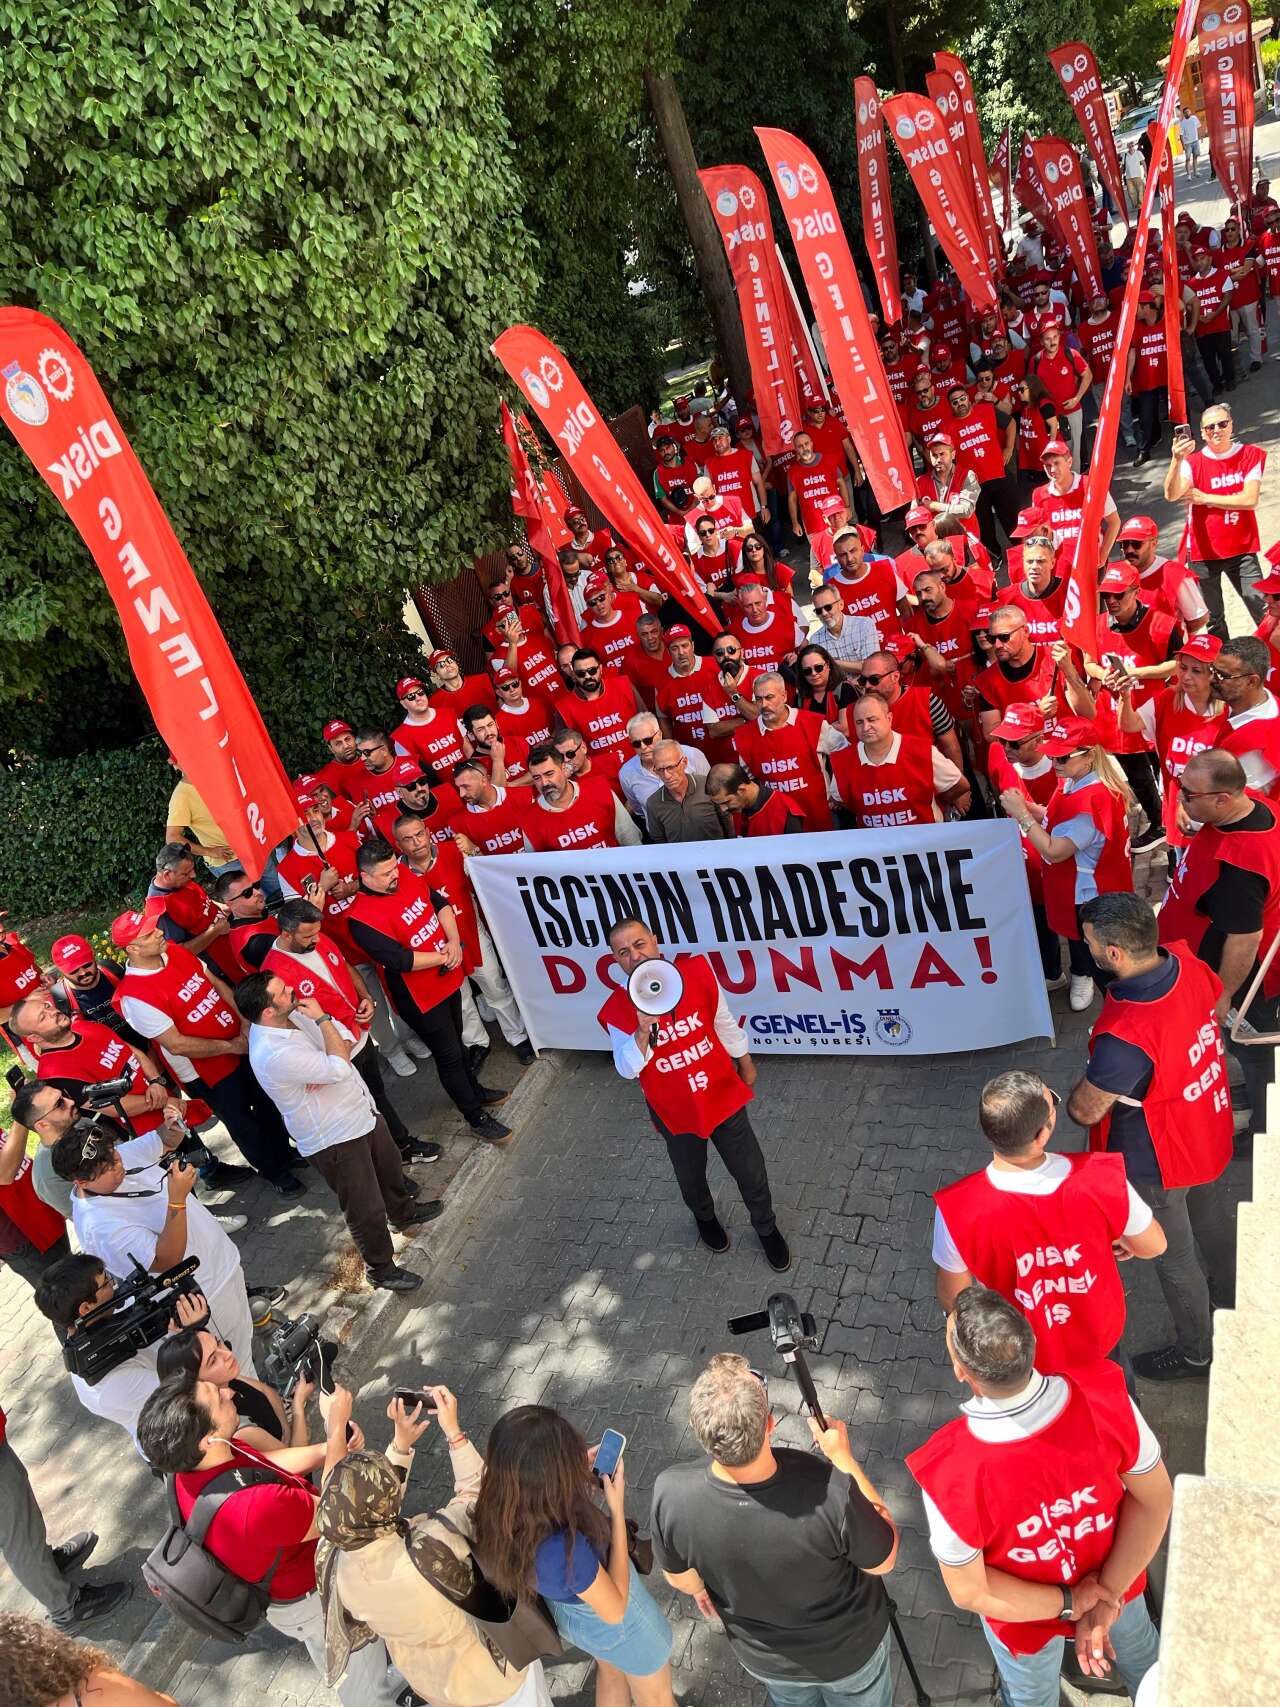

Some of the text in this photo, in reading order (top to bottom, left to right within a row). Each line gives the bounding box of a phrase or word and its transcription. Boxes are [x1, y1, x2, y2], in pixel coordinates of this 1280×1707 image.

[1197, 286, 1217, 298] DİSK
[1201, 296, 1221, 307] ENEL
[1092, 331, 1113, 344] DİSK
[1143, 333, 1164, 345] DİSK
[1141, 345, 1168, 357] GENEL
[960, 422, 984, 438] DİSK
[960, 434, 991, 451] GENEL
[718, 471, 740, 482] DİSK
[804, 475, 827, 486] DİSK
[1211, 473, 1245, 489] DİSK
[804, 487, 831, 498] GENEL
[1051, 508, 1083, 523] DİSK
[1224, 512, 1240, 526] İŞ
[711, 566, 734, 582] DİS
[848, 593, 881, 614] DİSK
[604, 635, 635, 655] DİSK
[744, 645, 775, 660] DİSK
[936, 639, 960, 654] İSK
[523, 651, 547, 671] DİSK
[528, 664, 558, 687] GENEL
[715, 703, 740, 720] DİS
[588, 712, 624, 733] DİSK
[428, 733, 457, 754] DİSK
[525, 728, 552, 746] DİSK
[692, 727, 705, 741] İŞ
[1172, 737, 1214, 757] DİS
[431, 749, 464, 771] GENE
[761, 757, 800, 775] DİSK
[863, 787, 908, 807] DİSK
[863, 809, 918, 829] GENEL
[430, 825, 456, 845] İSK
[485, 828, 523, 852] DİSK
[558, 822, 600, 848] DİSK
[697, 848, 988, 943] İRADESİNE
[401, 897, 428, 927] DİSK
[410, 913, 440, 949] GENE
[541, 936, 999, 995] DOUNMA!
[177, 972, 206, 1003] DİSK
[187, 987, 221, 1023] GENE
[657, 1011, 704, 1047] DİSK
[810, 1037, 871, 1048] ŞUBESİ
[99, 1039, 125, 1070] DİSK
[655, 1036, 714, 1074] GENEL
[688, 1070, 710, 1094] İŞ
[1016, 1243, 1083, 1278] DİSK
[1014, 1268, 1098, 1311] GENEL
[1044, 1303, 1072, 1329] İŞ
[1016, 1485, 1099, 1539] DİSK
[1007, 1513, 1114, 1563] GENEL
